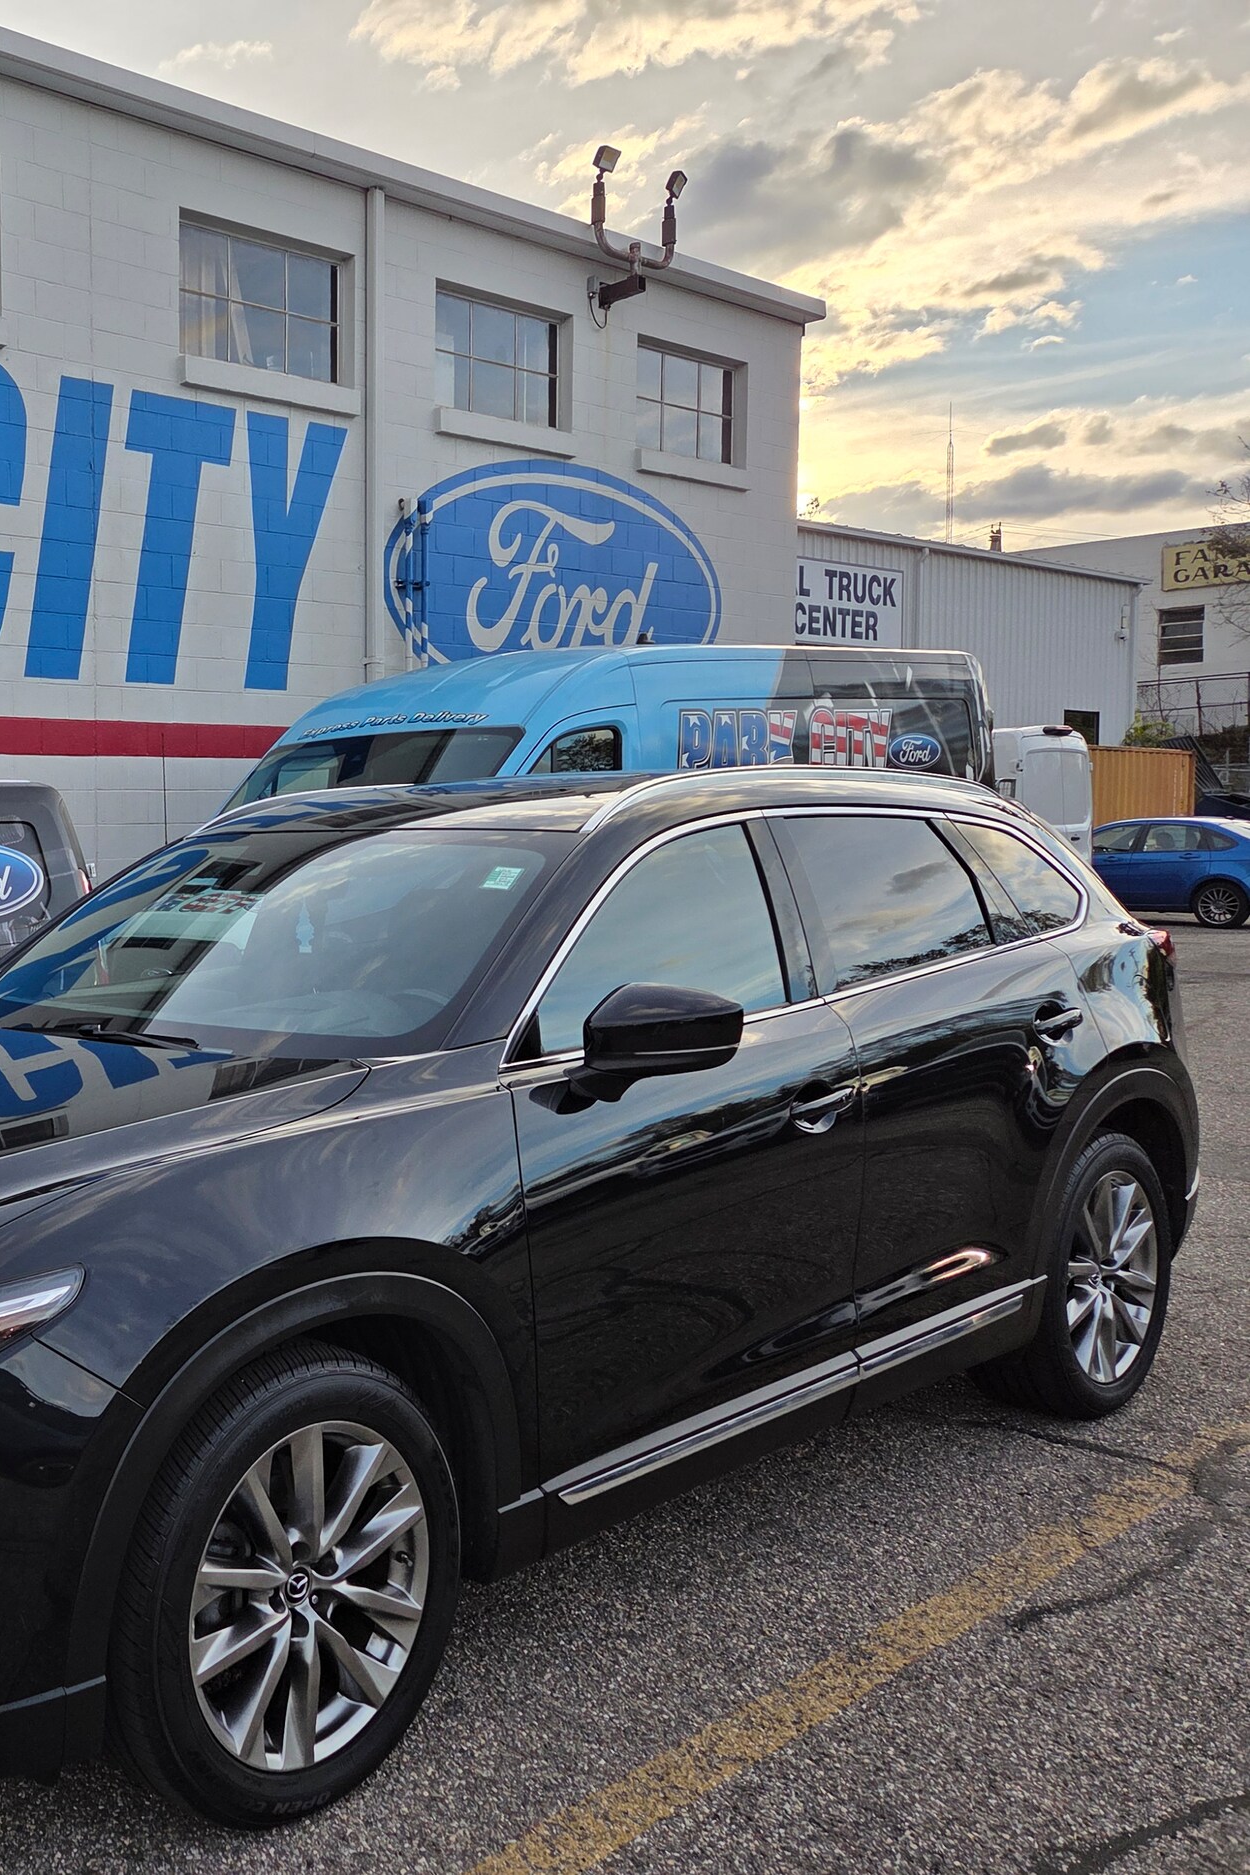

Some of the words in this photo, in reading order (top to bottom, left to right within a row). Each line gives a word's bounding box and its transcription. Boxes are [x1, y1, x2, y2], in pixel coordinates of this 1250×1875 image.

[466, 499, 658, 653] Ford
[796, 565, 810, 597] L
[824, 568, 897, 608] TRUCK
[795, 601, 879, 641] CENTER
[297, 720, 359, 741] Express
[359, 713, 408, 729] Parts
[407, 710, 490, 726] Delivery
[678, 708, 798, 769] PARK
[808, 705, 893, 767] CITY
[900, 739, 932, 764] Ford
